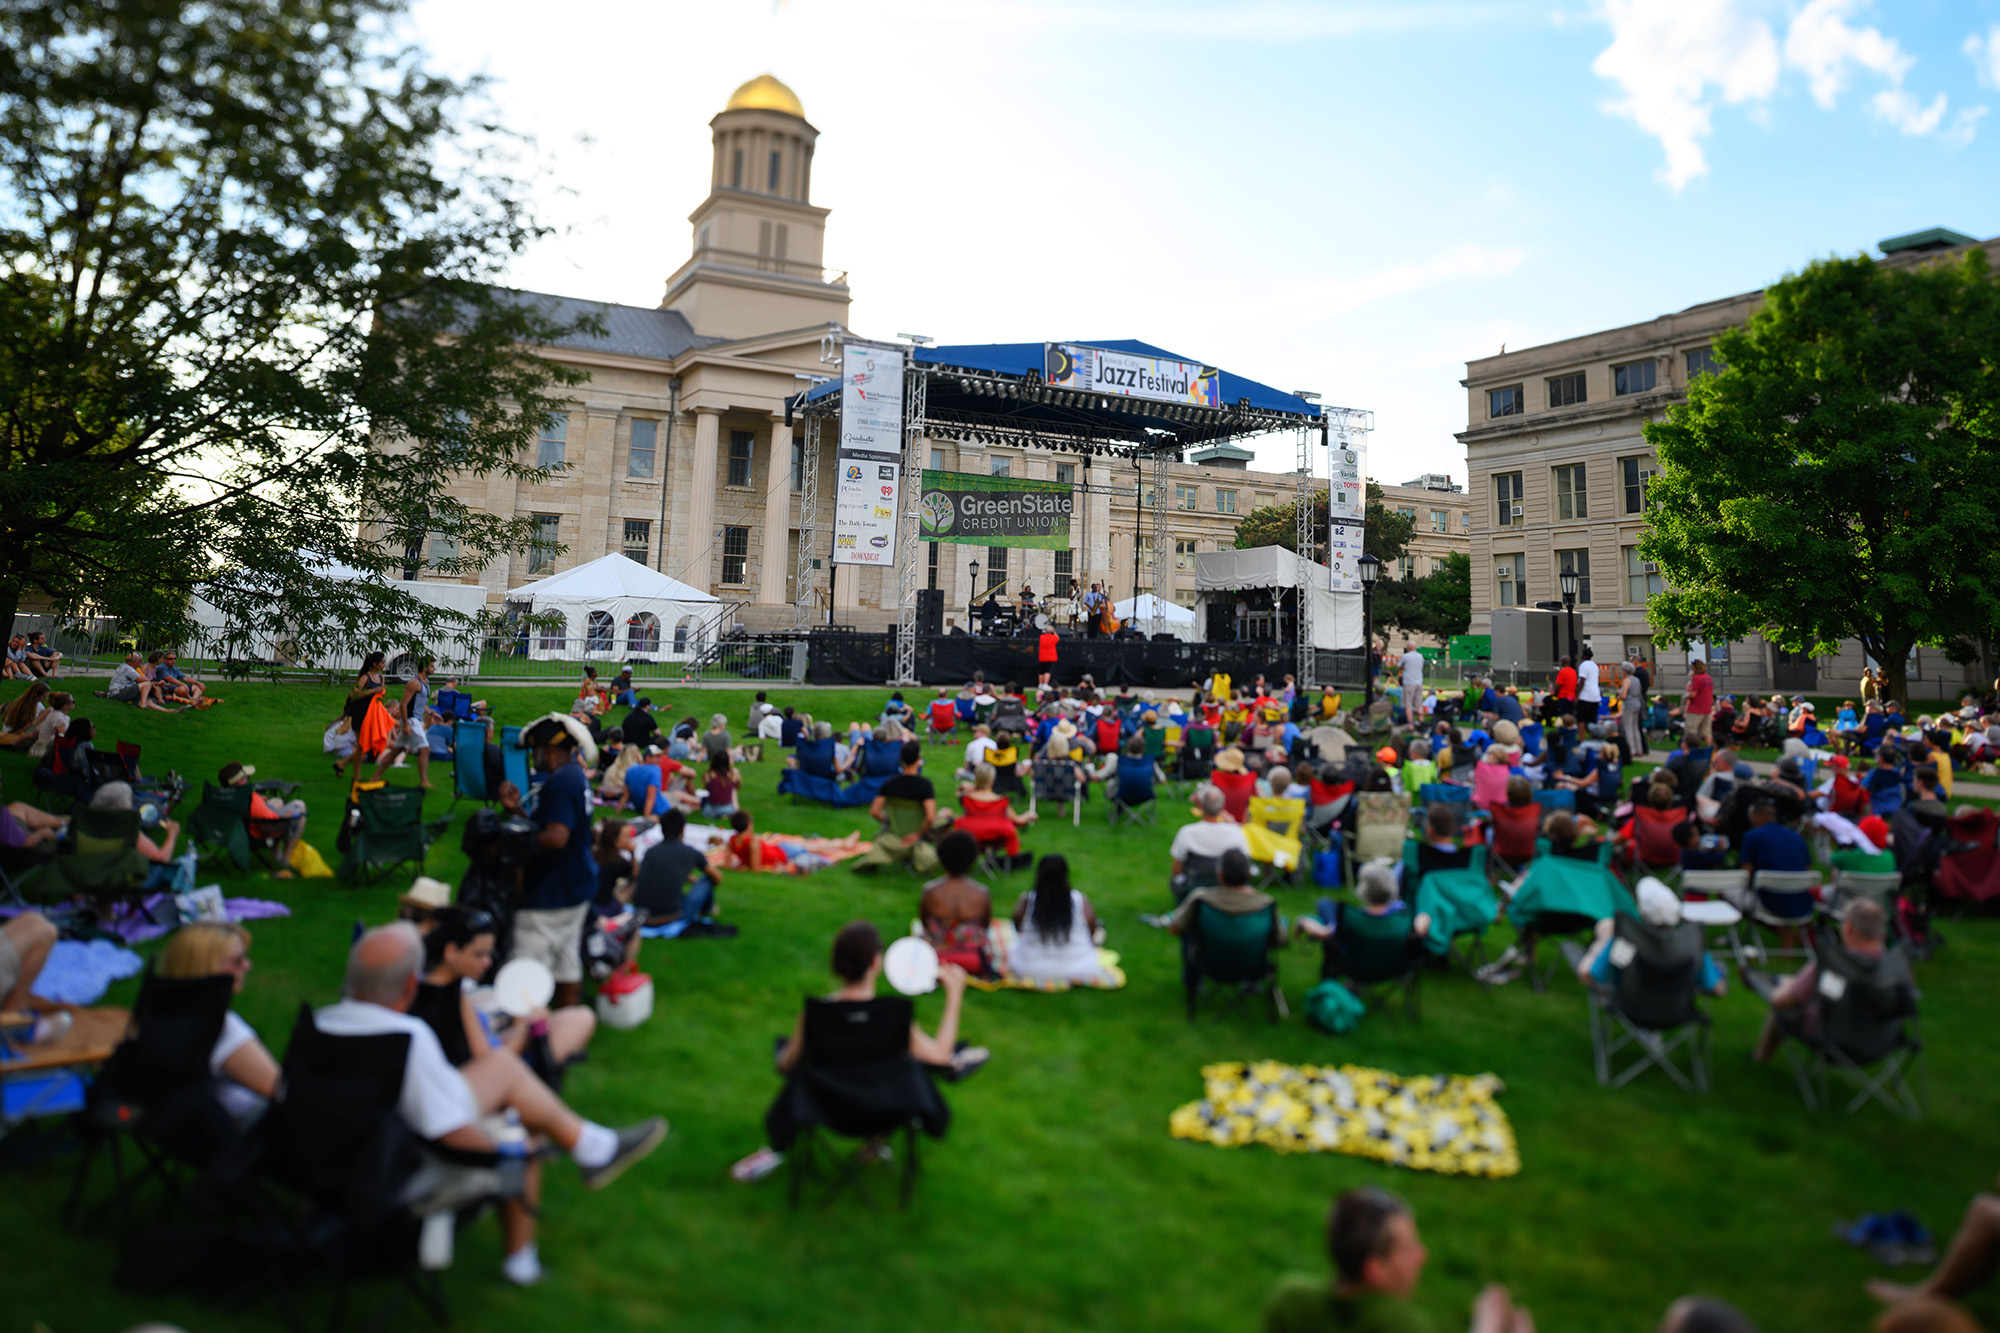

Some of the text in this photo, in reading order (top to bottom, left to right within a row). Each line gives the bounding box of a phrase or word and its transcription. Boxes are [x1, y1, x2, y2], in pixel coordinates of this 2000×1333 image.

[1095, 356, 1189, 395] Jazz Festival
[881, 421, 900, 429] COUNCIL
[868, 453, 891, 461] Sponsors
[1343, 481, 1362, 489] TOYOTA
[960, 494, 1072, 515] GreenState
[962, 516, 1059, 530] CREDIT UNION
[851, 552, 880, 562] DOWNBEAT
